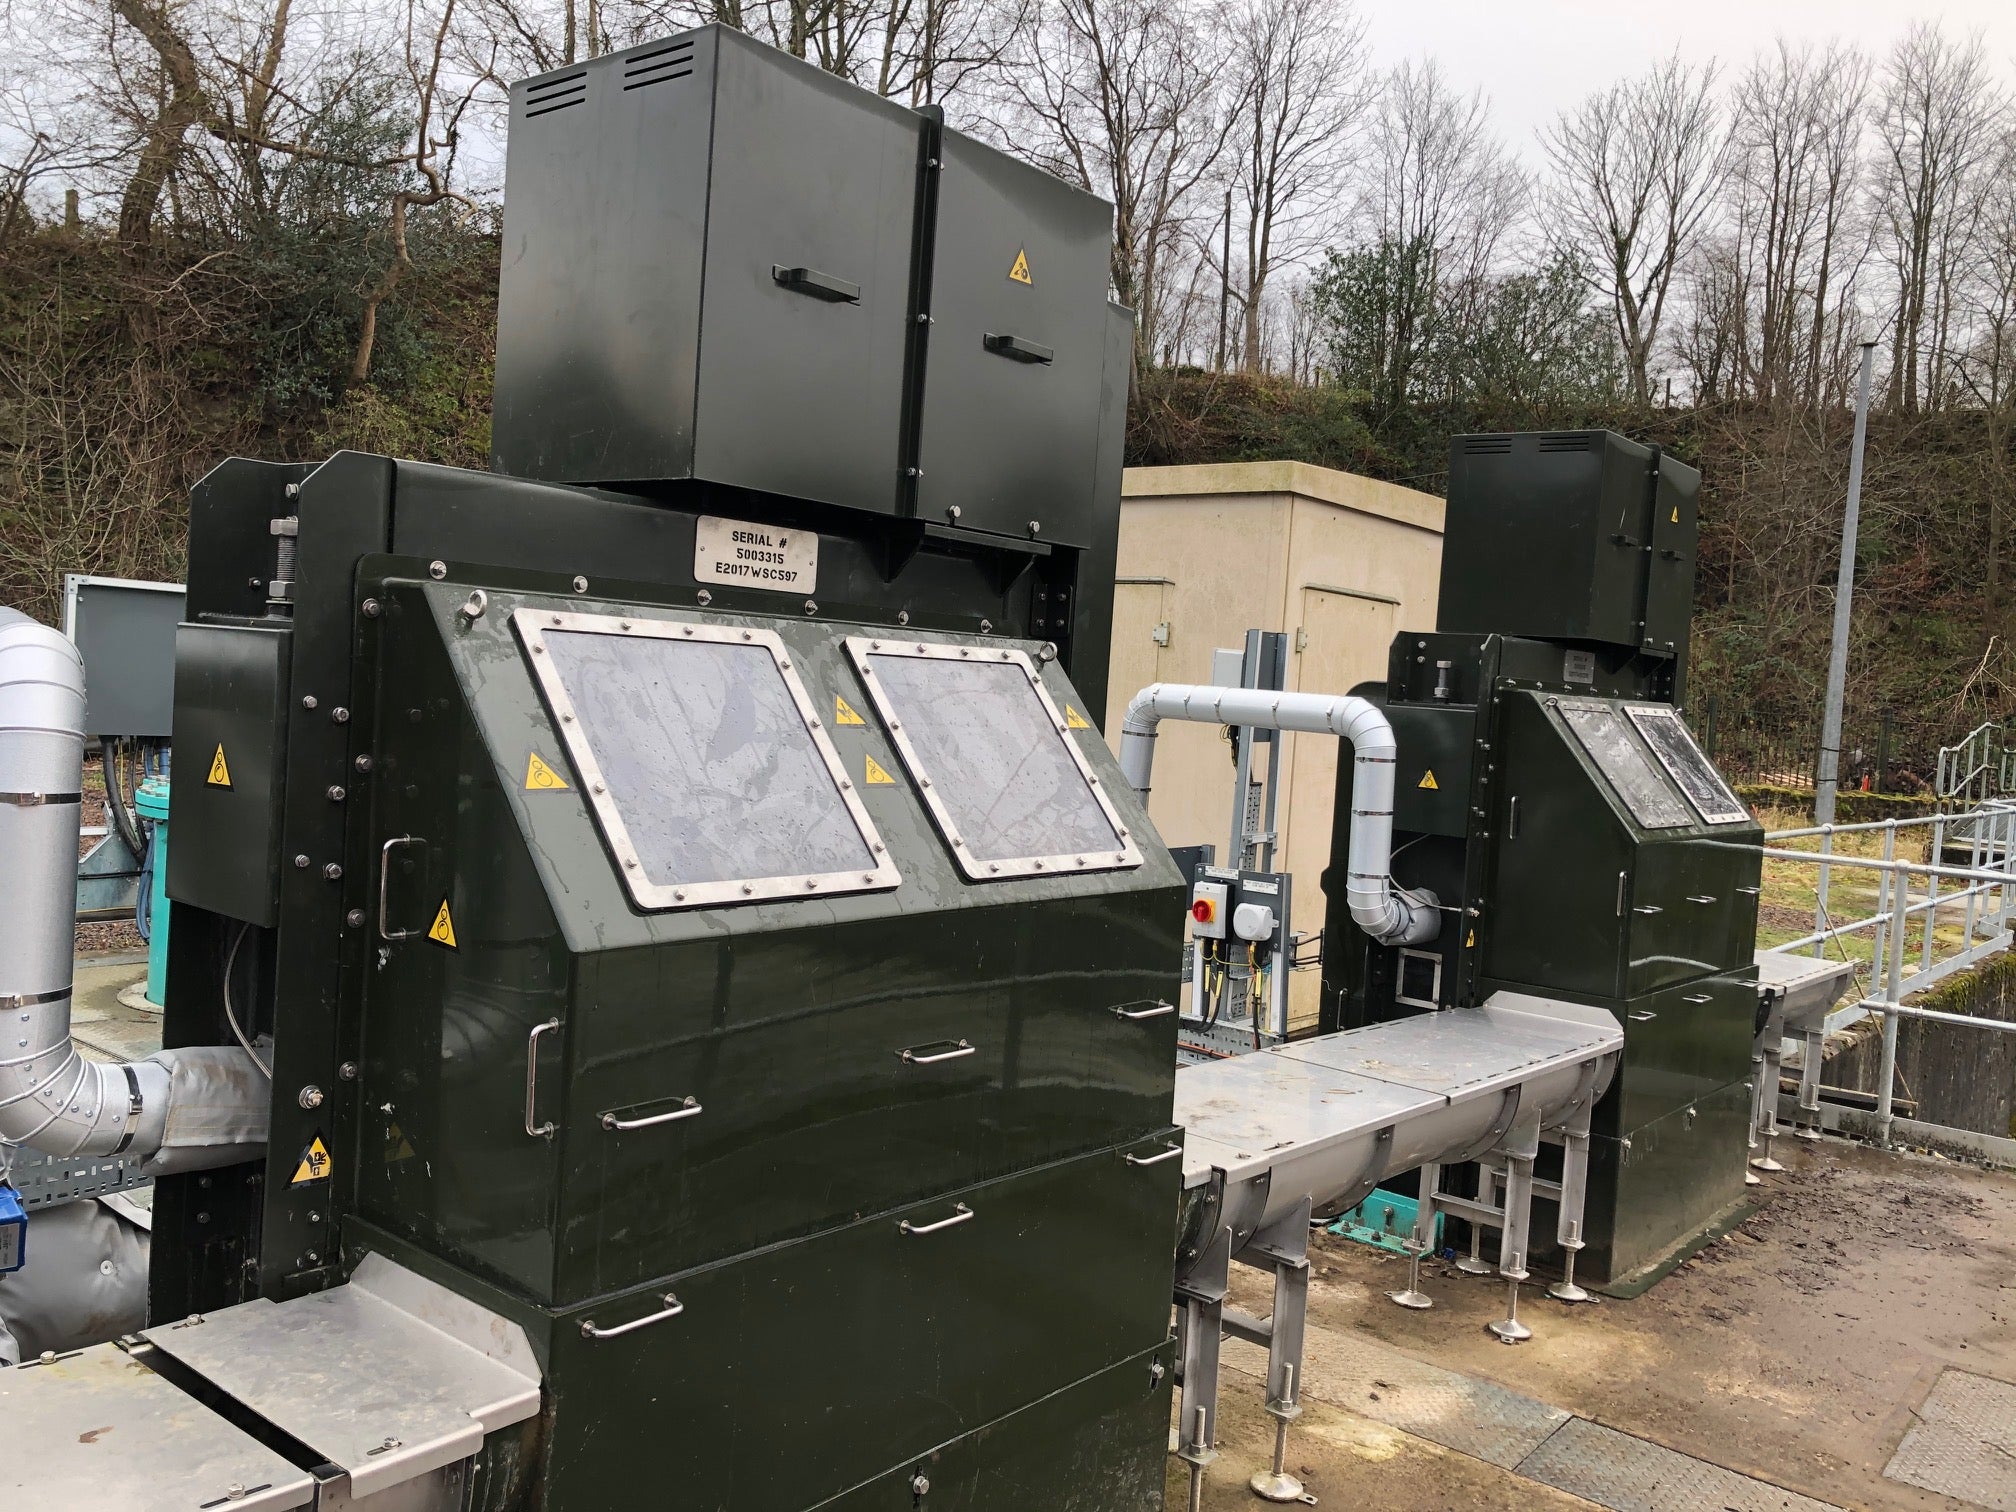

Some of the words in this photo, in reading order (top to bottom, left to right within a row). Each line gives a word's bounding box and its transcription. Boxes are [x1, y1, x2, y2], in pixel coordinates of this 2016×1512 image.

[732, 530, 773, 547] SERIAL
[779, 538, 787, 548] #
[736, 547, 785, 564] 5003315
[715, 561, 798, 582] E2017WSC597
